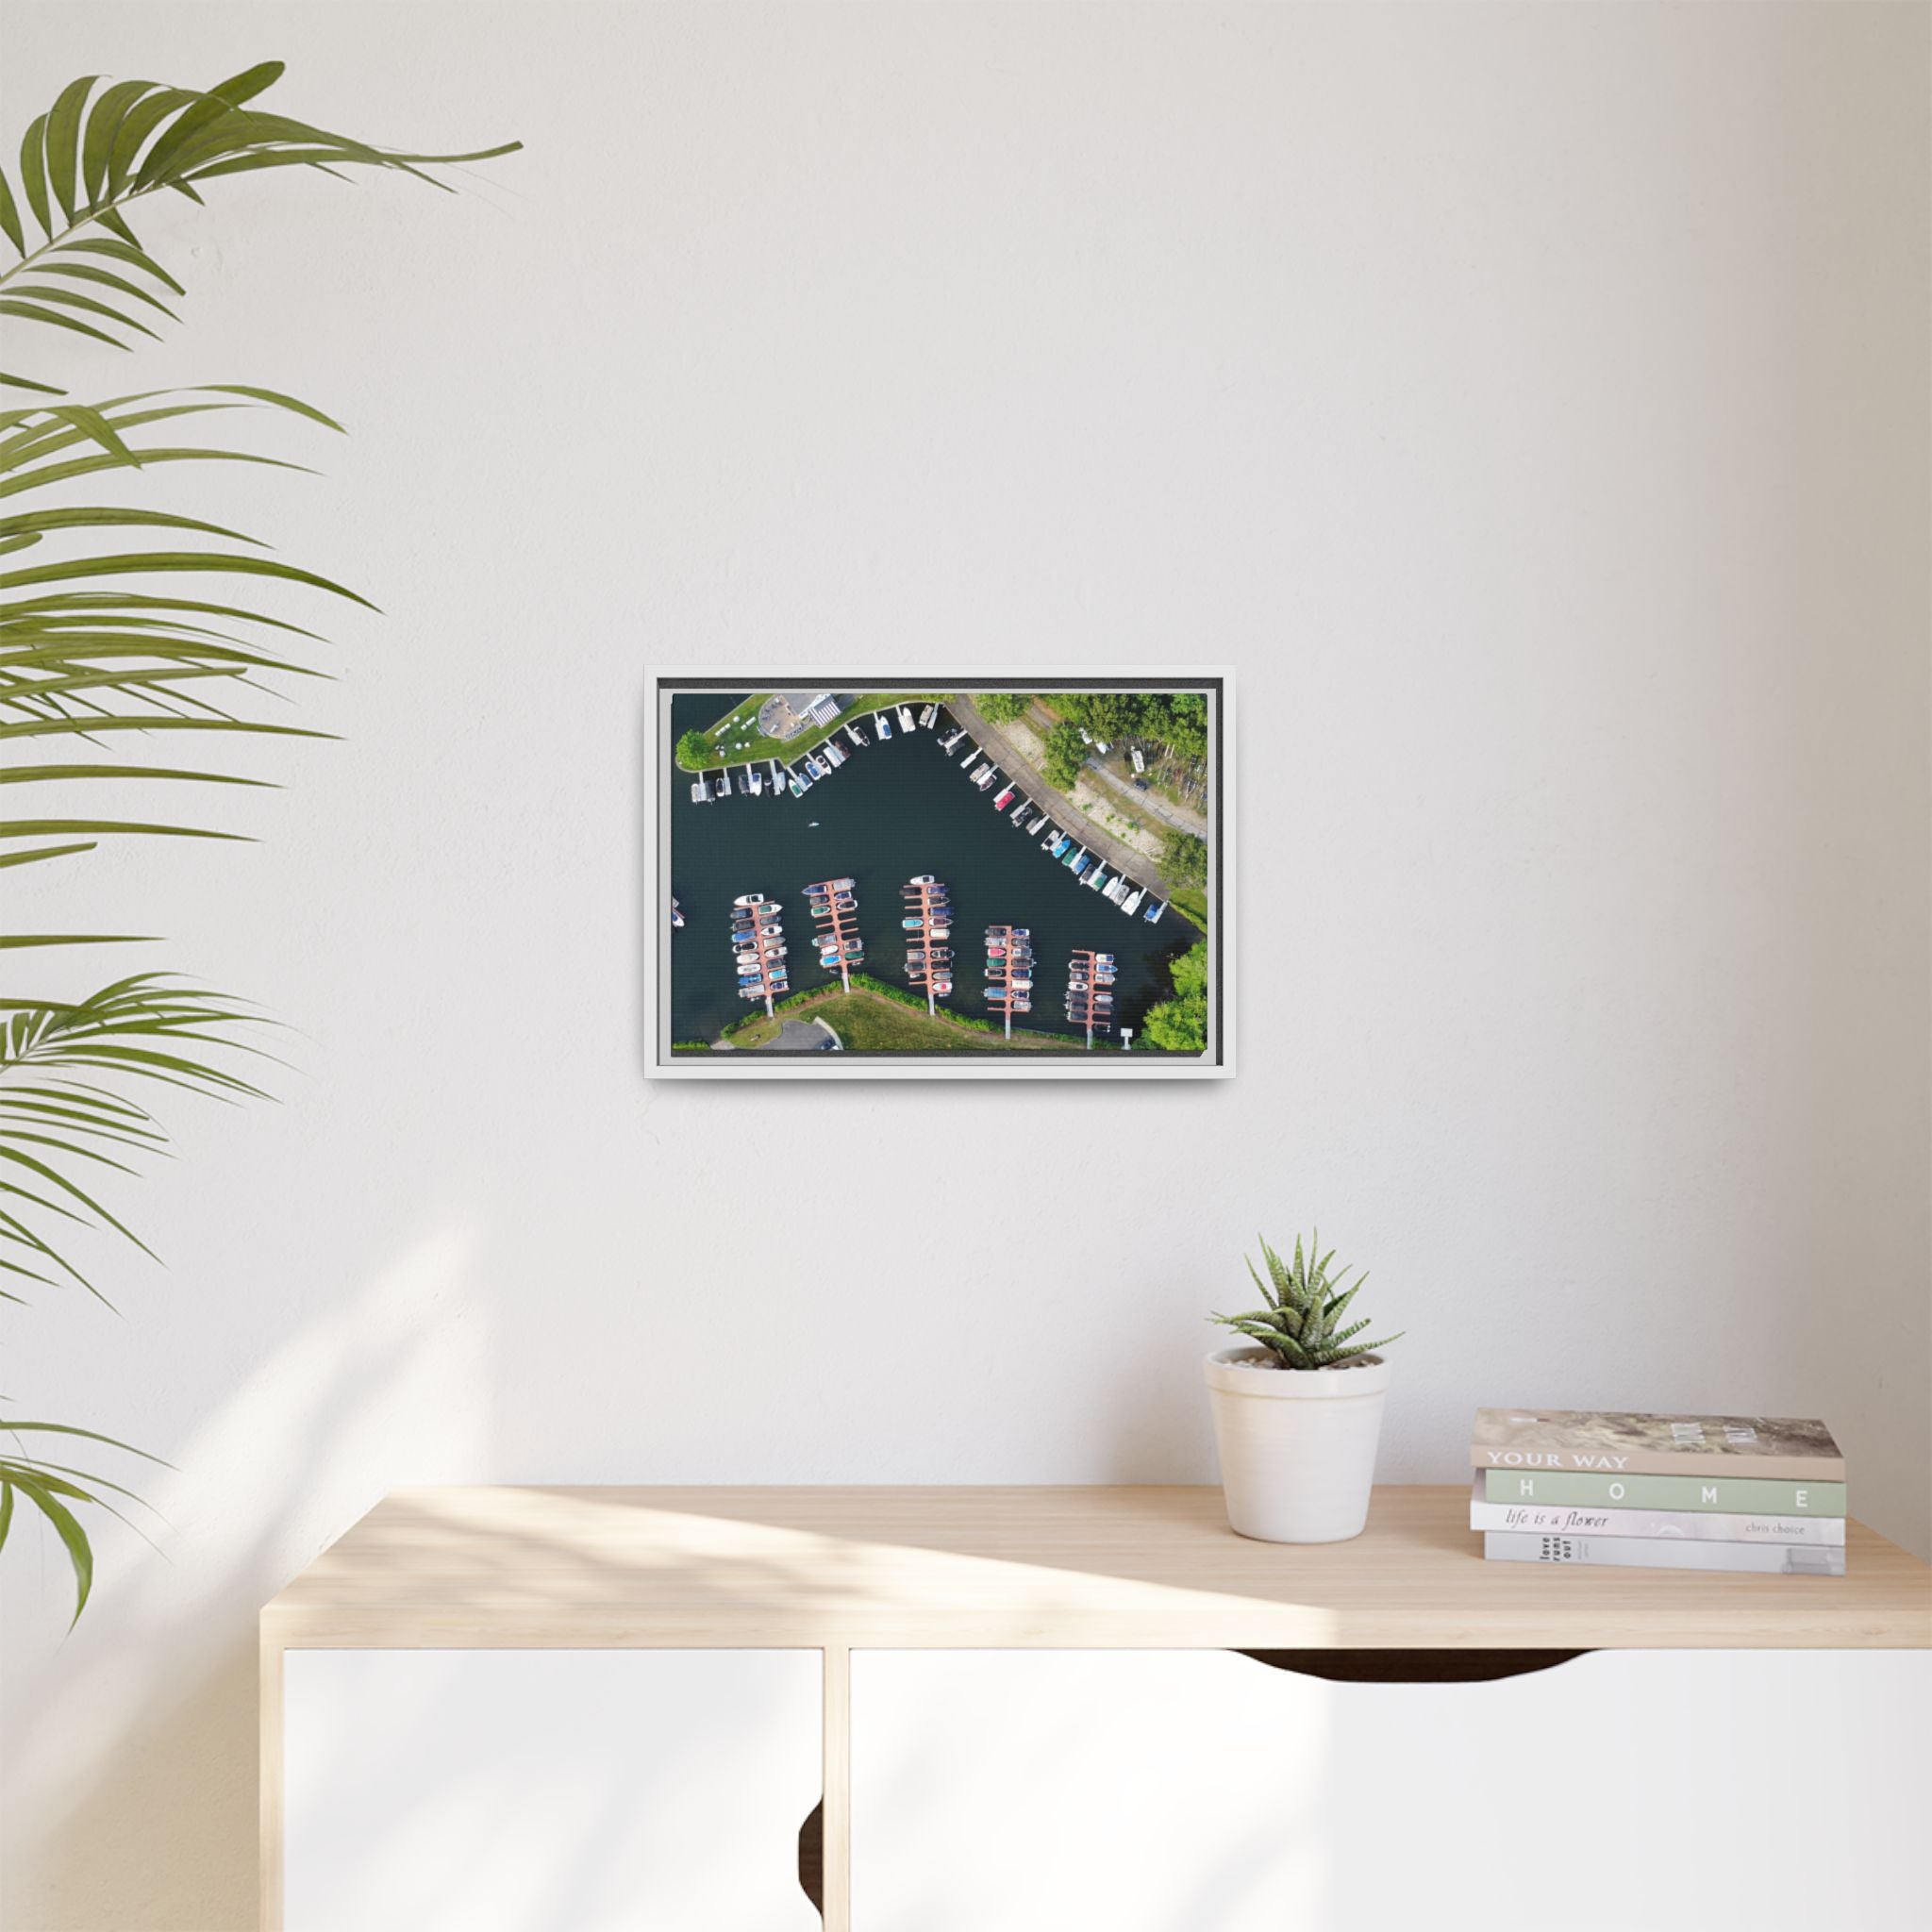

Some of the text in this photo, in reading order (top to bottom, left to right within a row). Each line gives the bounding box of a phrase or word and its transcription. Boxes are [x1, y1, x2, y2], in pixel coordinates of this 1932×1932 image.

[1487, 1451, 1629, 1470] YOUR WAY
[1520, 1479, 1807, 1507] HOME
[1505, 1508, 1609, 1531] life is a flower
[1745, 1521, 1770, 1533] chris
[1539, 1537, 1551, 1560] love
[1553, 1537, 1561, 1561] runs
[1562, 1540, 1572, 1559] out
